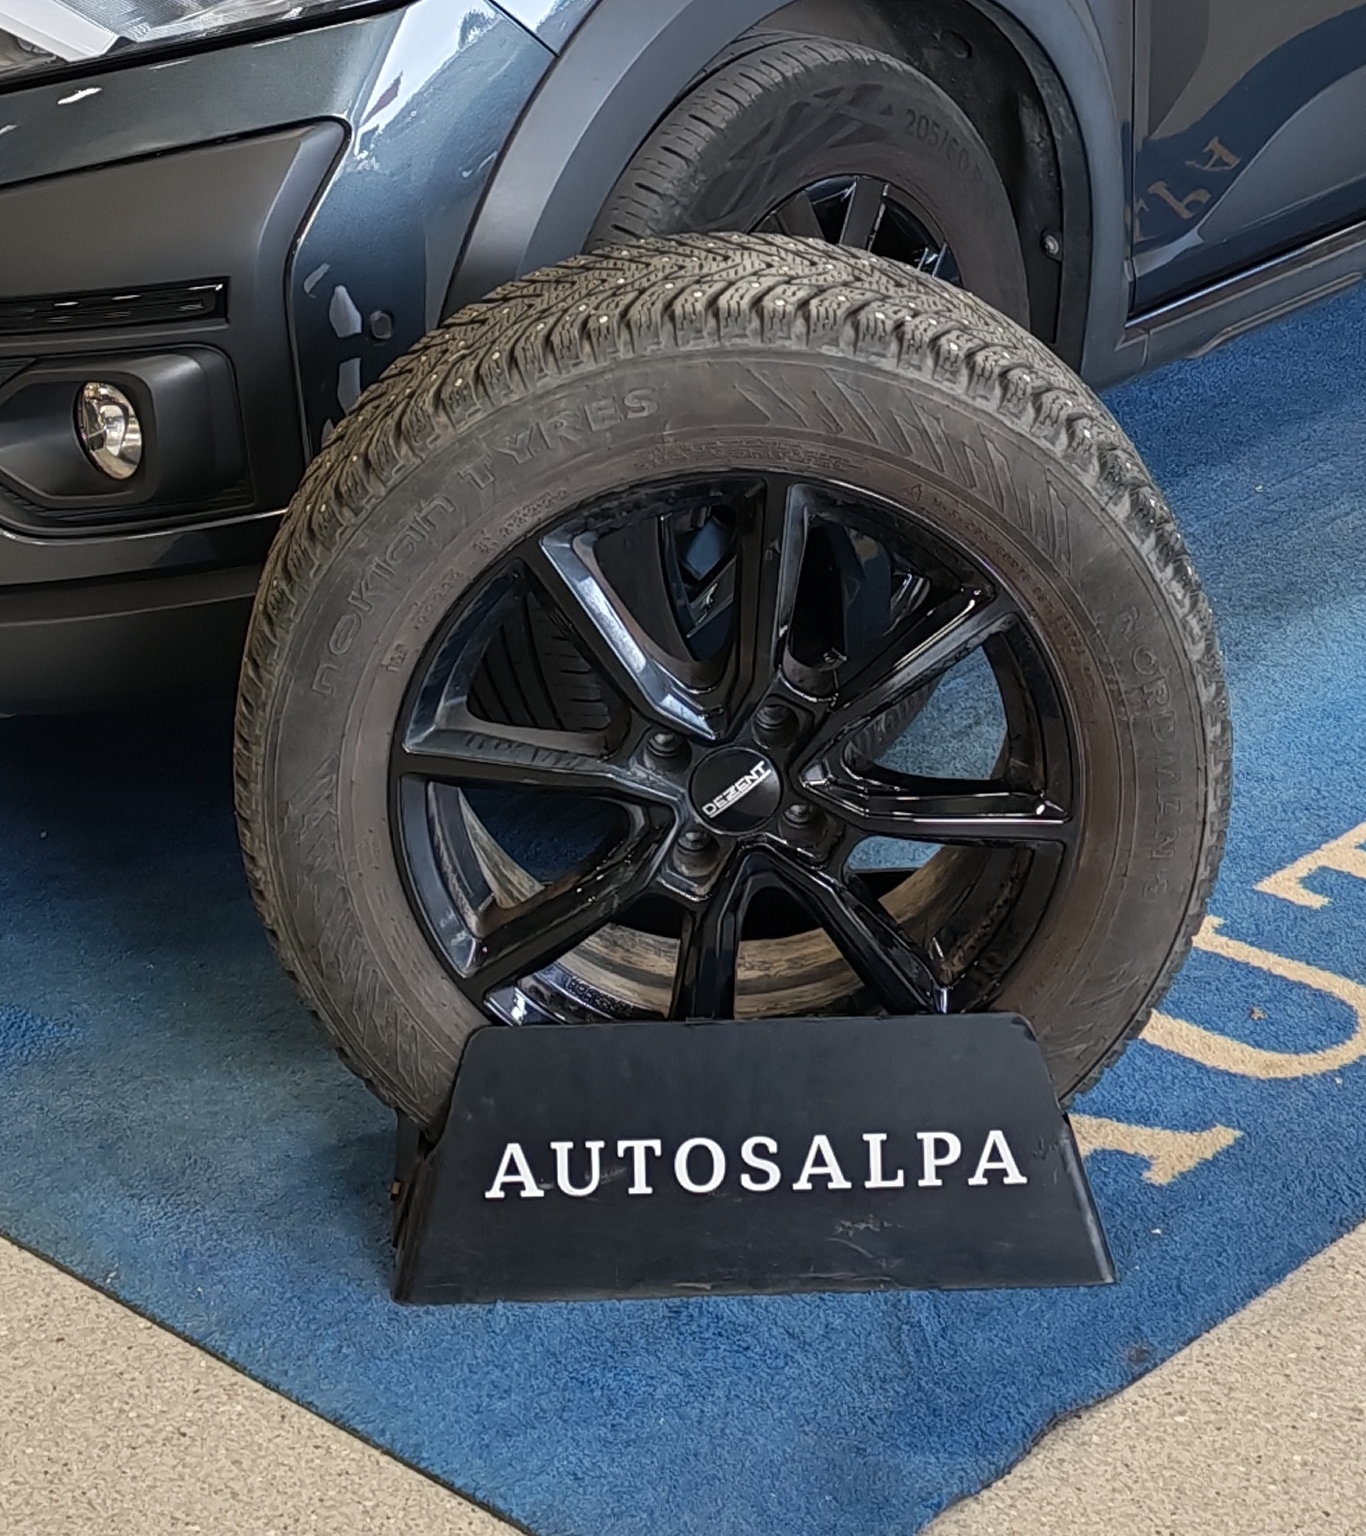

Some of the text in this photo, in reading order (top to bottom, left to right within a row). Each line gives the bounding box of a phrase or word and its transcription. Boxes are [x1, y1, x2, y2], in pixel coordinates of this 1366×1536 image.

[311, 495, 455, 695] nokian
[455, 387, 660, 490] TYRES
[701, 759, 770, 817] DEZENT
[484, 1129, 1028, 1200] AUTOSALPA
